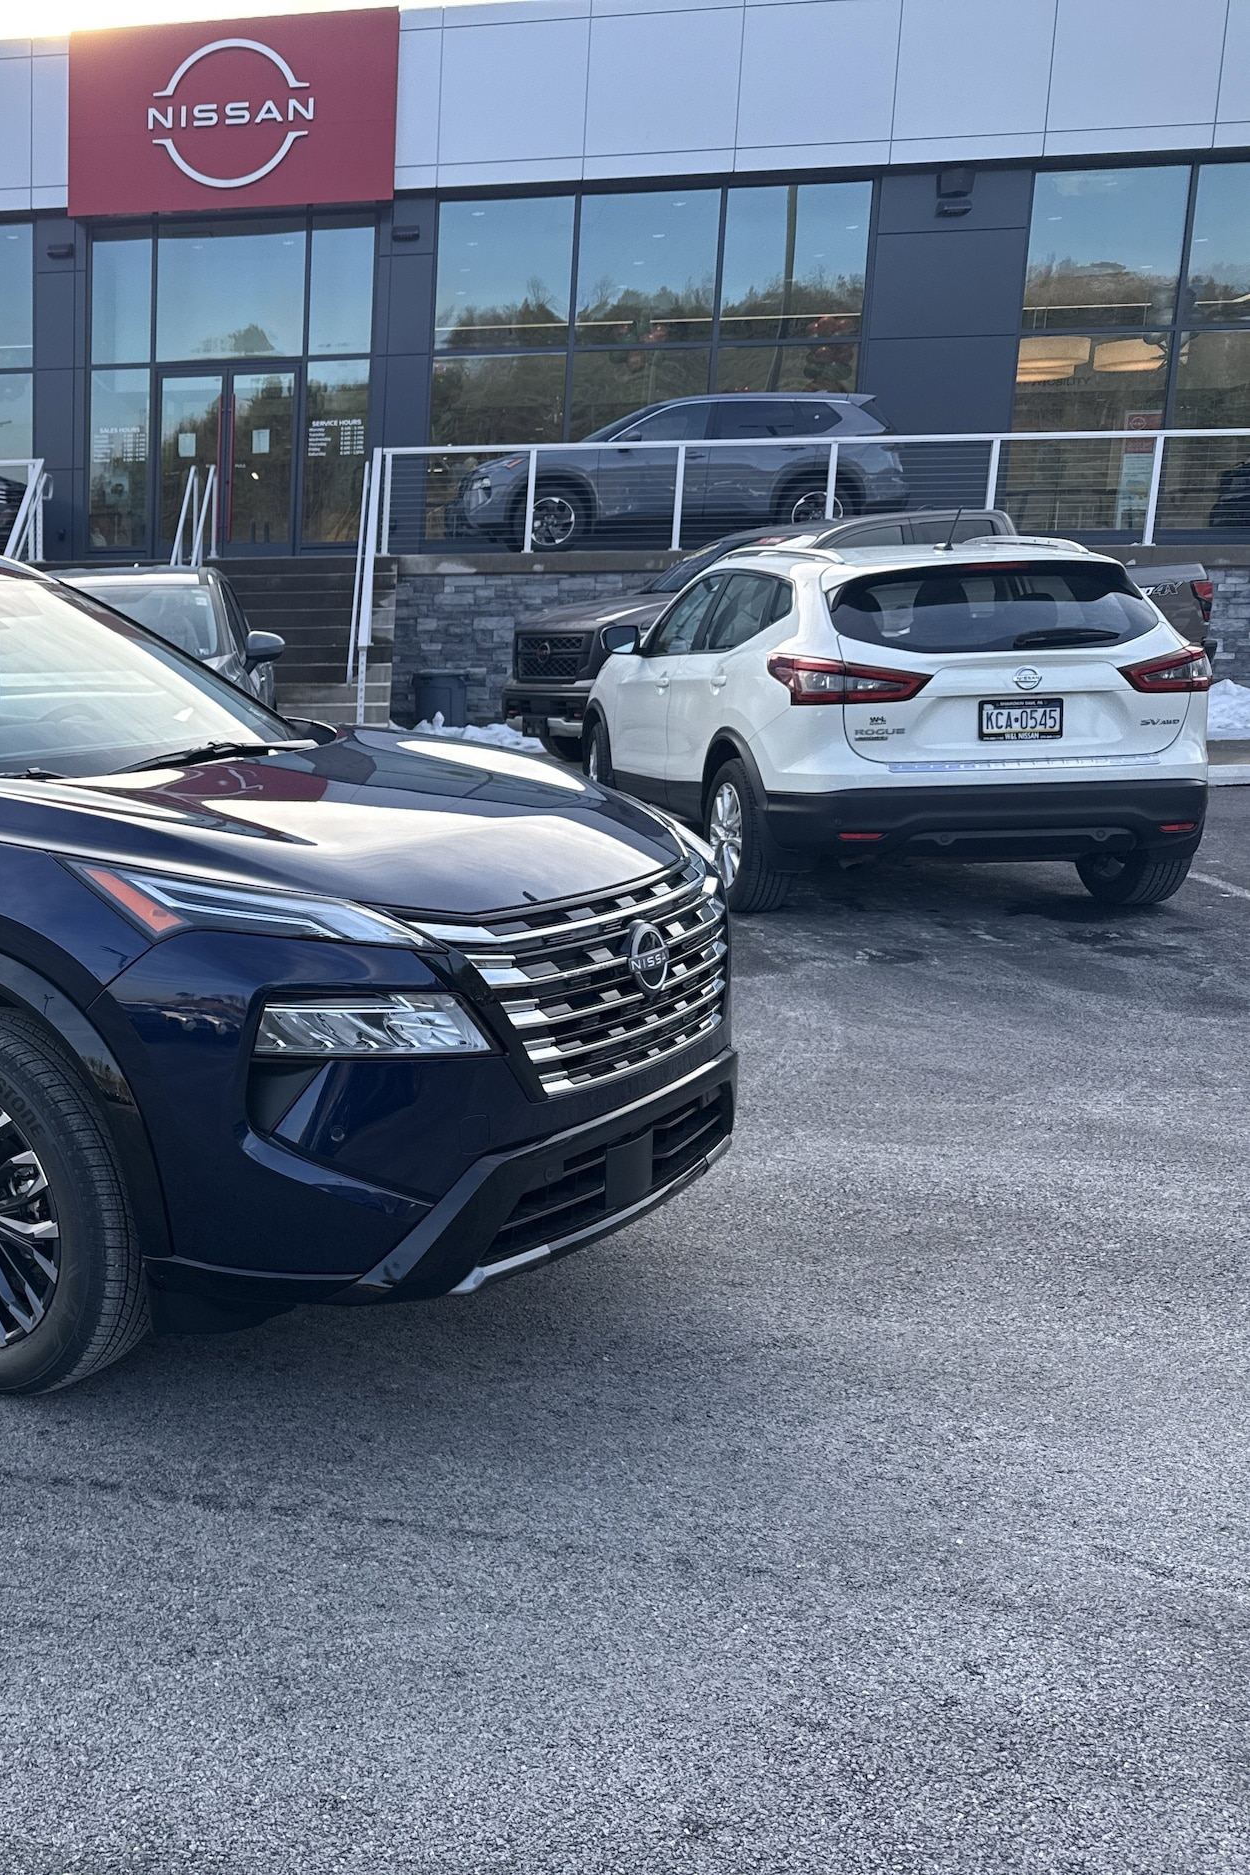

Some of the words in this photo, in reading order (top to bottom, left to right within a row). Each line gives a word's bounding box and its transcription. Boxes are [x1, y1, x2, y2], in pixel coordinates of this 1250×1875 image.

[147, 97, 315, 130] NISSAN
[1140, 718, 1160, 726] SV
[1018, 732, 1039, 740] NISSAN
